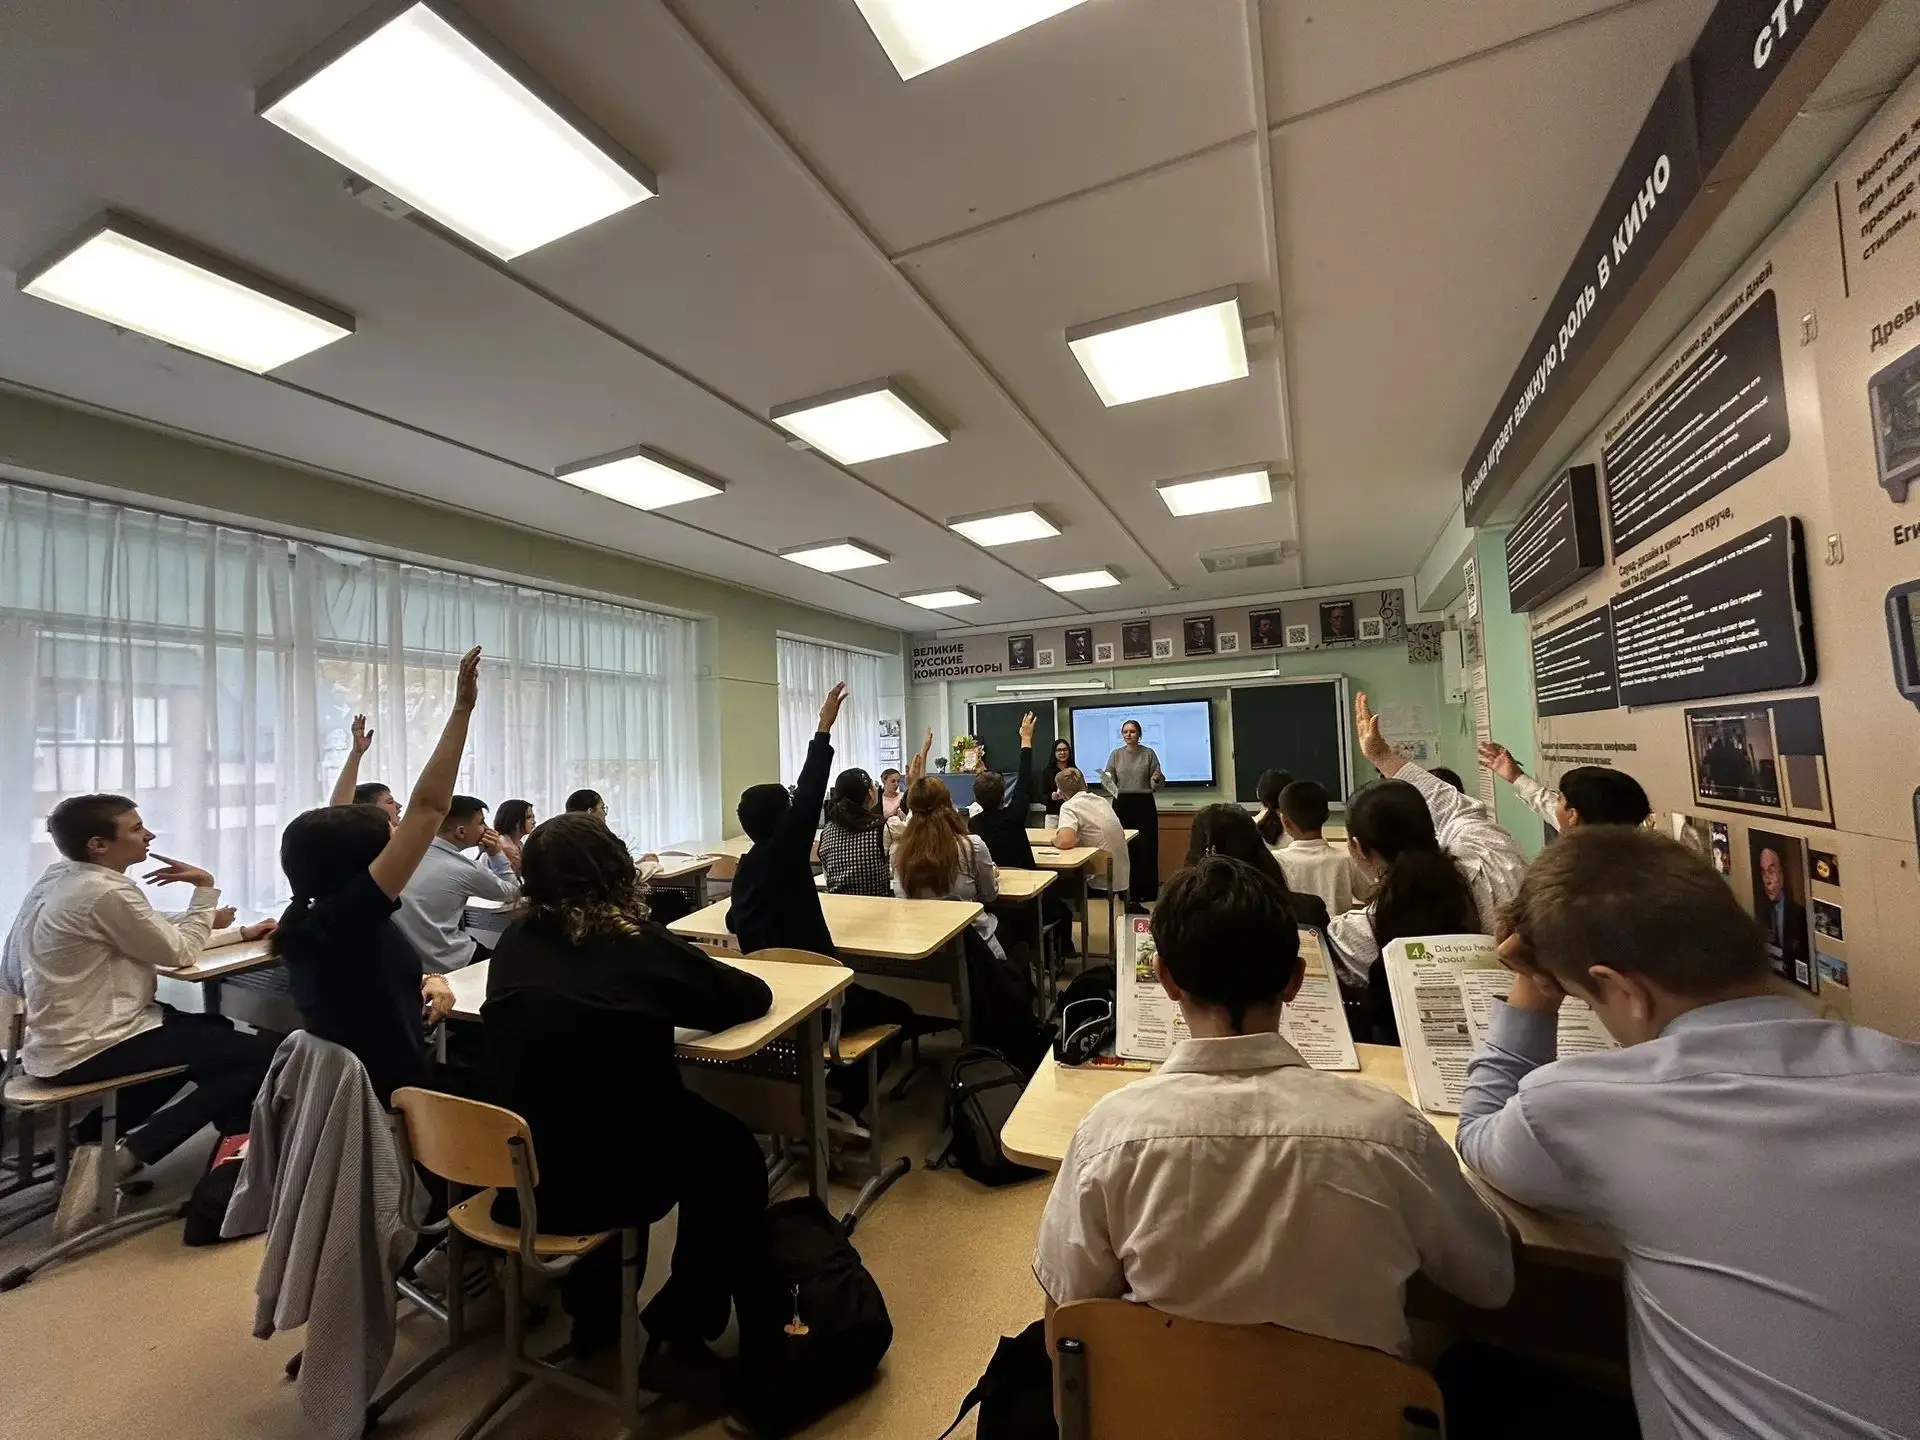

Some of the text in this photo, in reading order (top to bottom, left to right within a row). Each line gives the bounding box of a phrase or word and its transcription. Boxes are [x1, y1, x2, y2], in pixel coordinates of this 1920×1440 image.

[1753, 0, 1804, 69] ст
[1857, 132, 1907, 191] Многие
[1859, 182, 1883, 214] при
[1861, 181, 1914, 237] прежде
[1701, 326, 1713, 348] до
[1713, 292, 1744, 331] наших
[1746, 259, 1773, 302] дней
[1487, 414, 1513, 470] играет
[1514, 344, 1557, 427] важную
[1558, 284, 1596, 362] роль
[1597, 254, 1610, 290] в
[1690, 523, 1704, 538] это
[1705, 507, 1735, 531] круче,
[1631, 573, 1640, 585] ты
[913, 643, 964, 657] ВЕЛИКИЕ
[914, 655, 963, 668] РУССКИЕ
[914, 662, 1003, 680] КОМПОЗИТОРЫ
[1411, 947, 1421, 958] 4
[1434, 944, 1452, 953] Did
[1453, 944, 1472, 953] you
[1437, 955, 1466, 964] about
